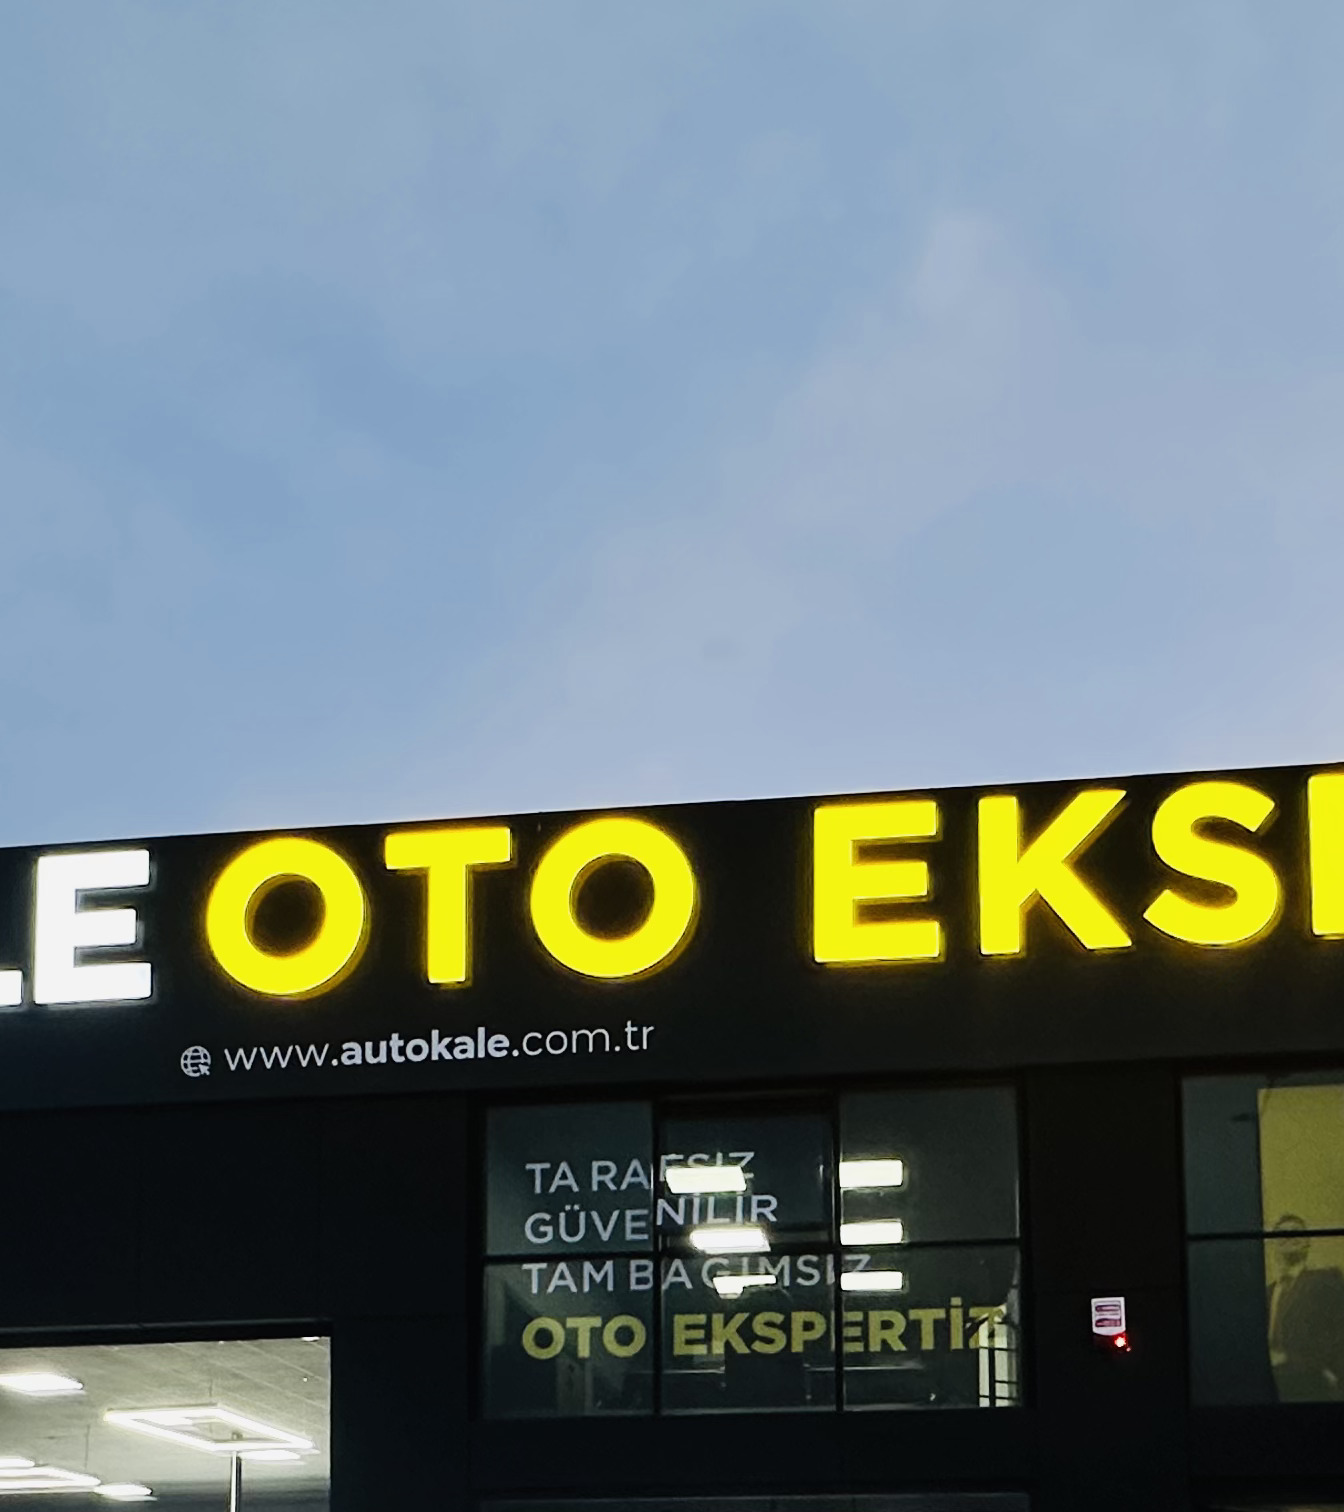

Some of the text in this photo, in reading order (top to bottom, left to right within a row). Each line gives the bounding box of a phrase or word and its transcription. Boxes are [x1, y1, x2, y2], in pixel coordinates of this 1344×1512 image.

[207, 817, 695, 995] OTO
[225, 1020, 654, 1072] www.autokale.com.tr
[522, 1261, 615, 1294] TAM
[522, 1315, 647, 1360] OTO
